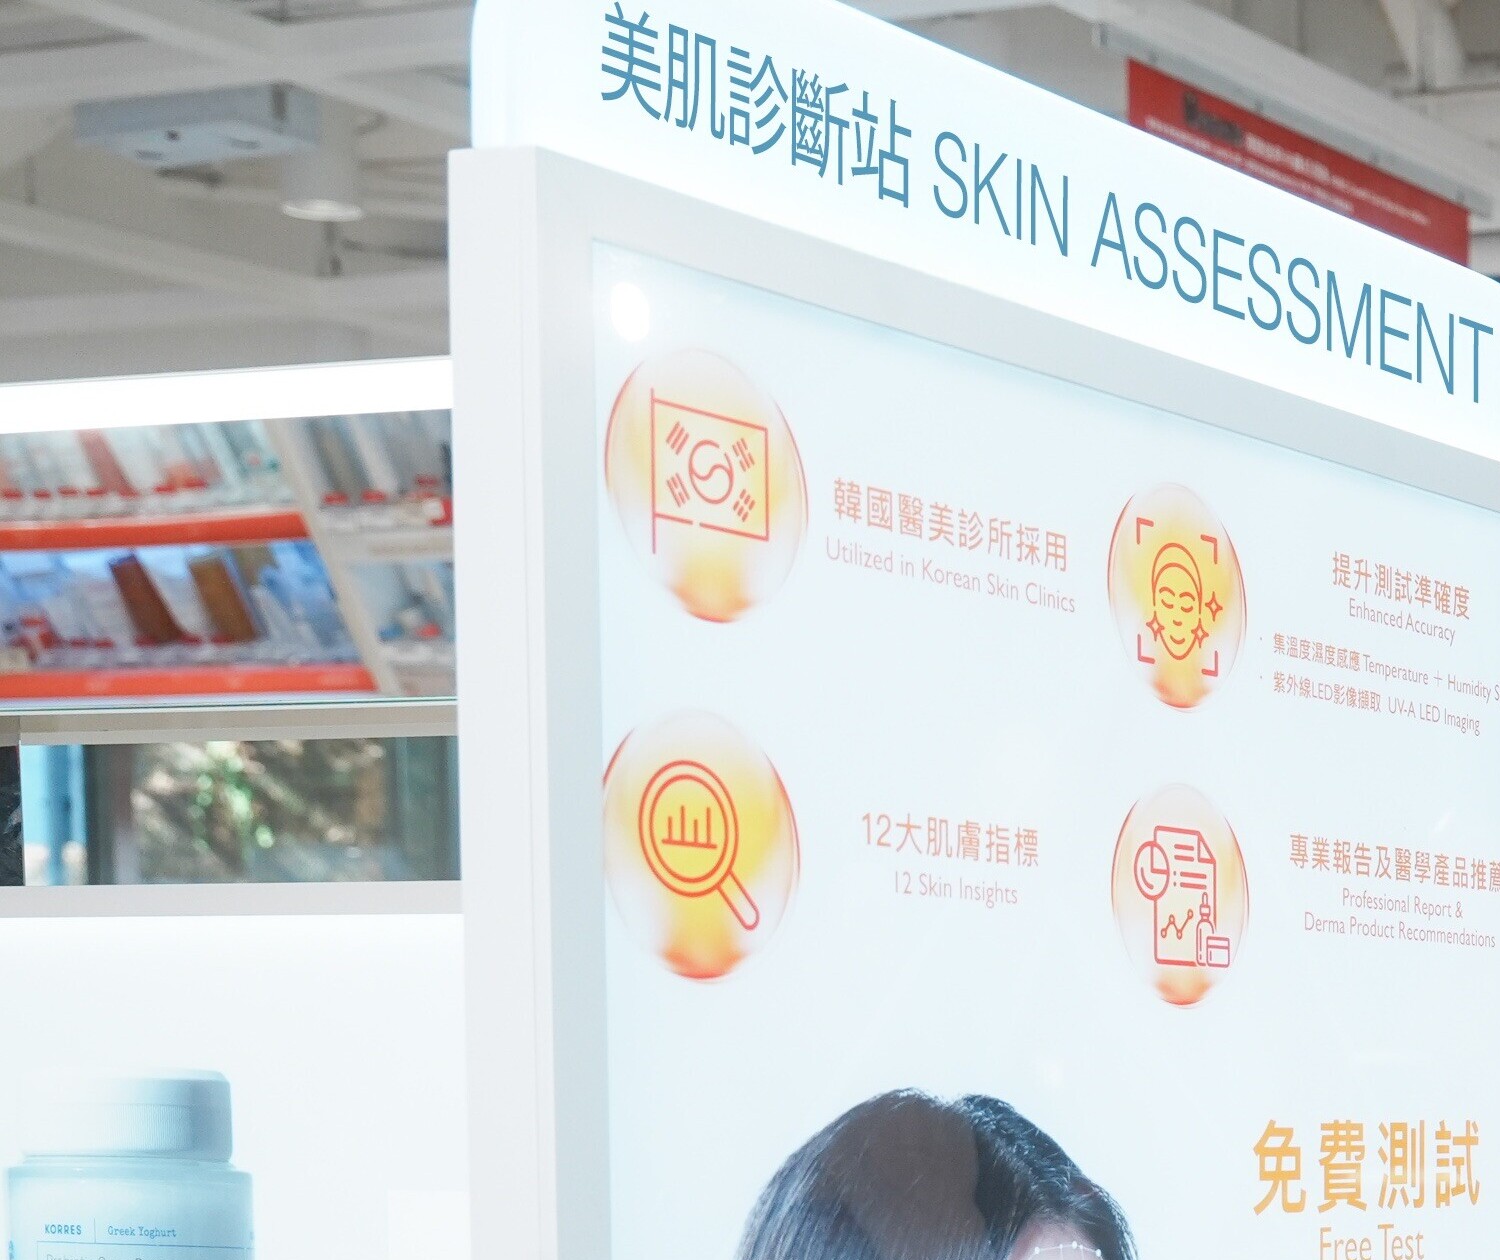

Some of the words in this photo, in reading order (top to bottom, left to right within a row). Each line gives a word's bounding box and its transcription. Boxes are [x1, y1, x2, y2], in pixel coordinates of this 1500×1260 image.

[600, 9, 911, 208] 美肌診斷站
[932, 129, 1070, 258] SKIN
[1091, 190, 1494, 404] ASSESSMENT
[833, 477, 1069, 572] 韓國醫美診所採用
[826, 536, 893, 574] Utilized
[900, 554, 914, 578] in
[922, 558, 981, 592] Korean
[987, 572, 1019, 601] Skin
[1025, 581, 1075, 613] Clinics
[1332, 551, 1471, 620] 提升測試準確度
[1349, 597, 1402, 629] Enhanced
[1405, 613, 1456, 646] Accuracy
[1363, 654, 1428, 687] Temperature
[1448, 673, 1490, 704] Humidity
[1388, 696, 1416, 719] UV-A
[1419, 703, 1440, 725] LED
[1444, 711, 1481, 737] Imaging
[862, 812, 1040, 868] 12大肌膚指標
[895, 871, 913, 896] 12
[919, 873, 952, 900] Skin
[959, 877, 1018, 910] Insights
[1342, 888, 1410, 914] Professional
[1414, 900, 1452, 920] Report
[1455, 901, 1464, 920] &
[1304, 911, 1346, 935] Derma
[1350, 916, 1395, 940] Product
[1398, 921, 1496, 949] Recommendations
[1253, 1119, 1480, 1216] 免費測試
[45, 1224, 82, 1236] KORRES
[108, 1226, 135, 1237] Greek
[138, 1226, 177, 1240] Yoghurt
